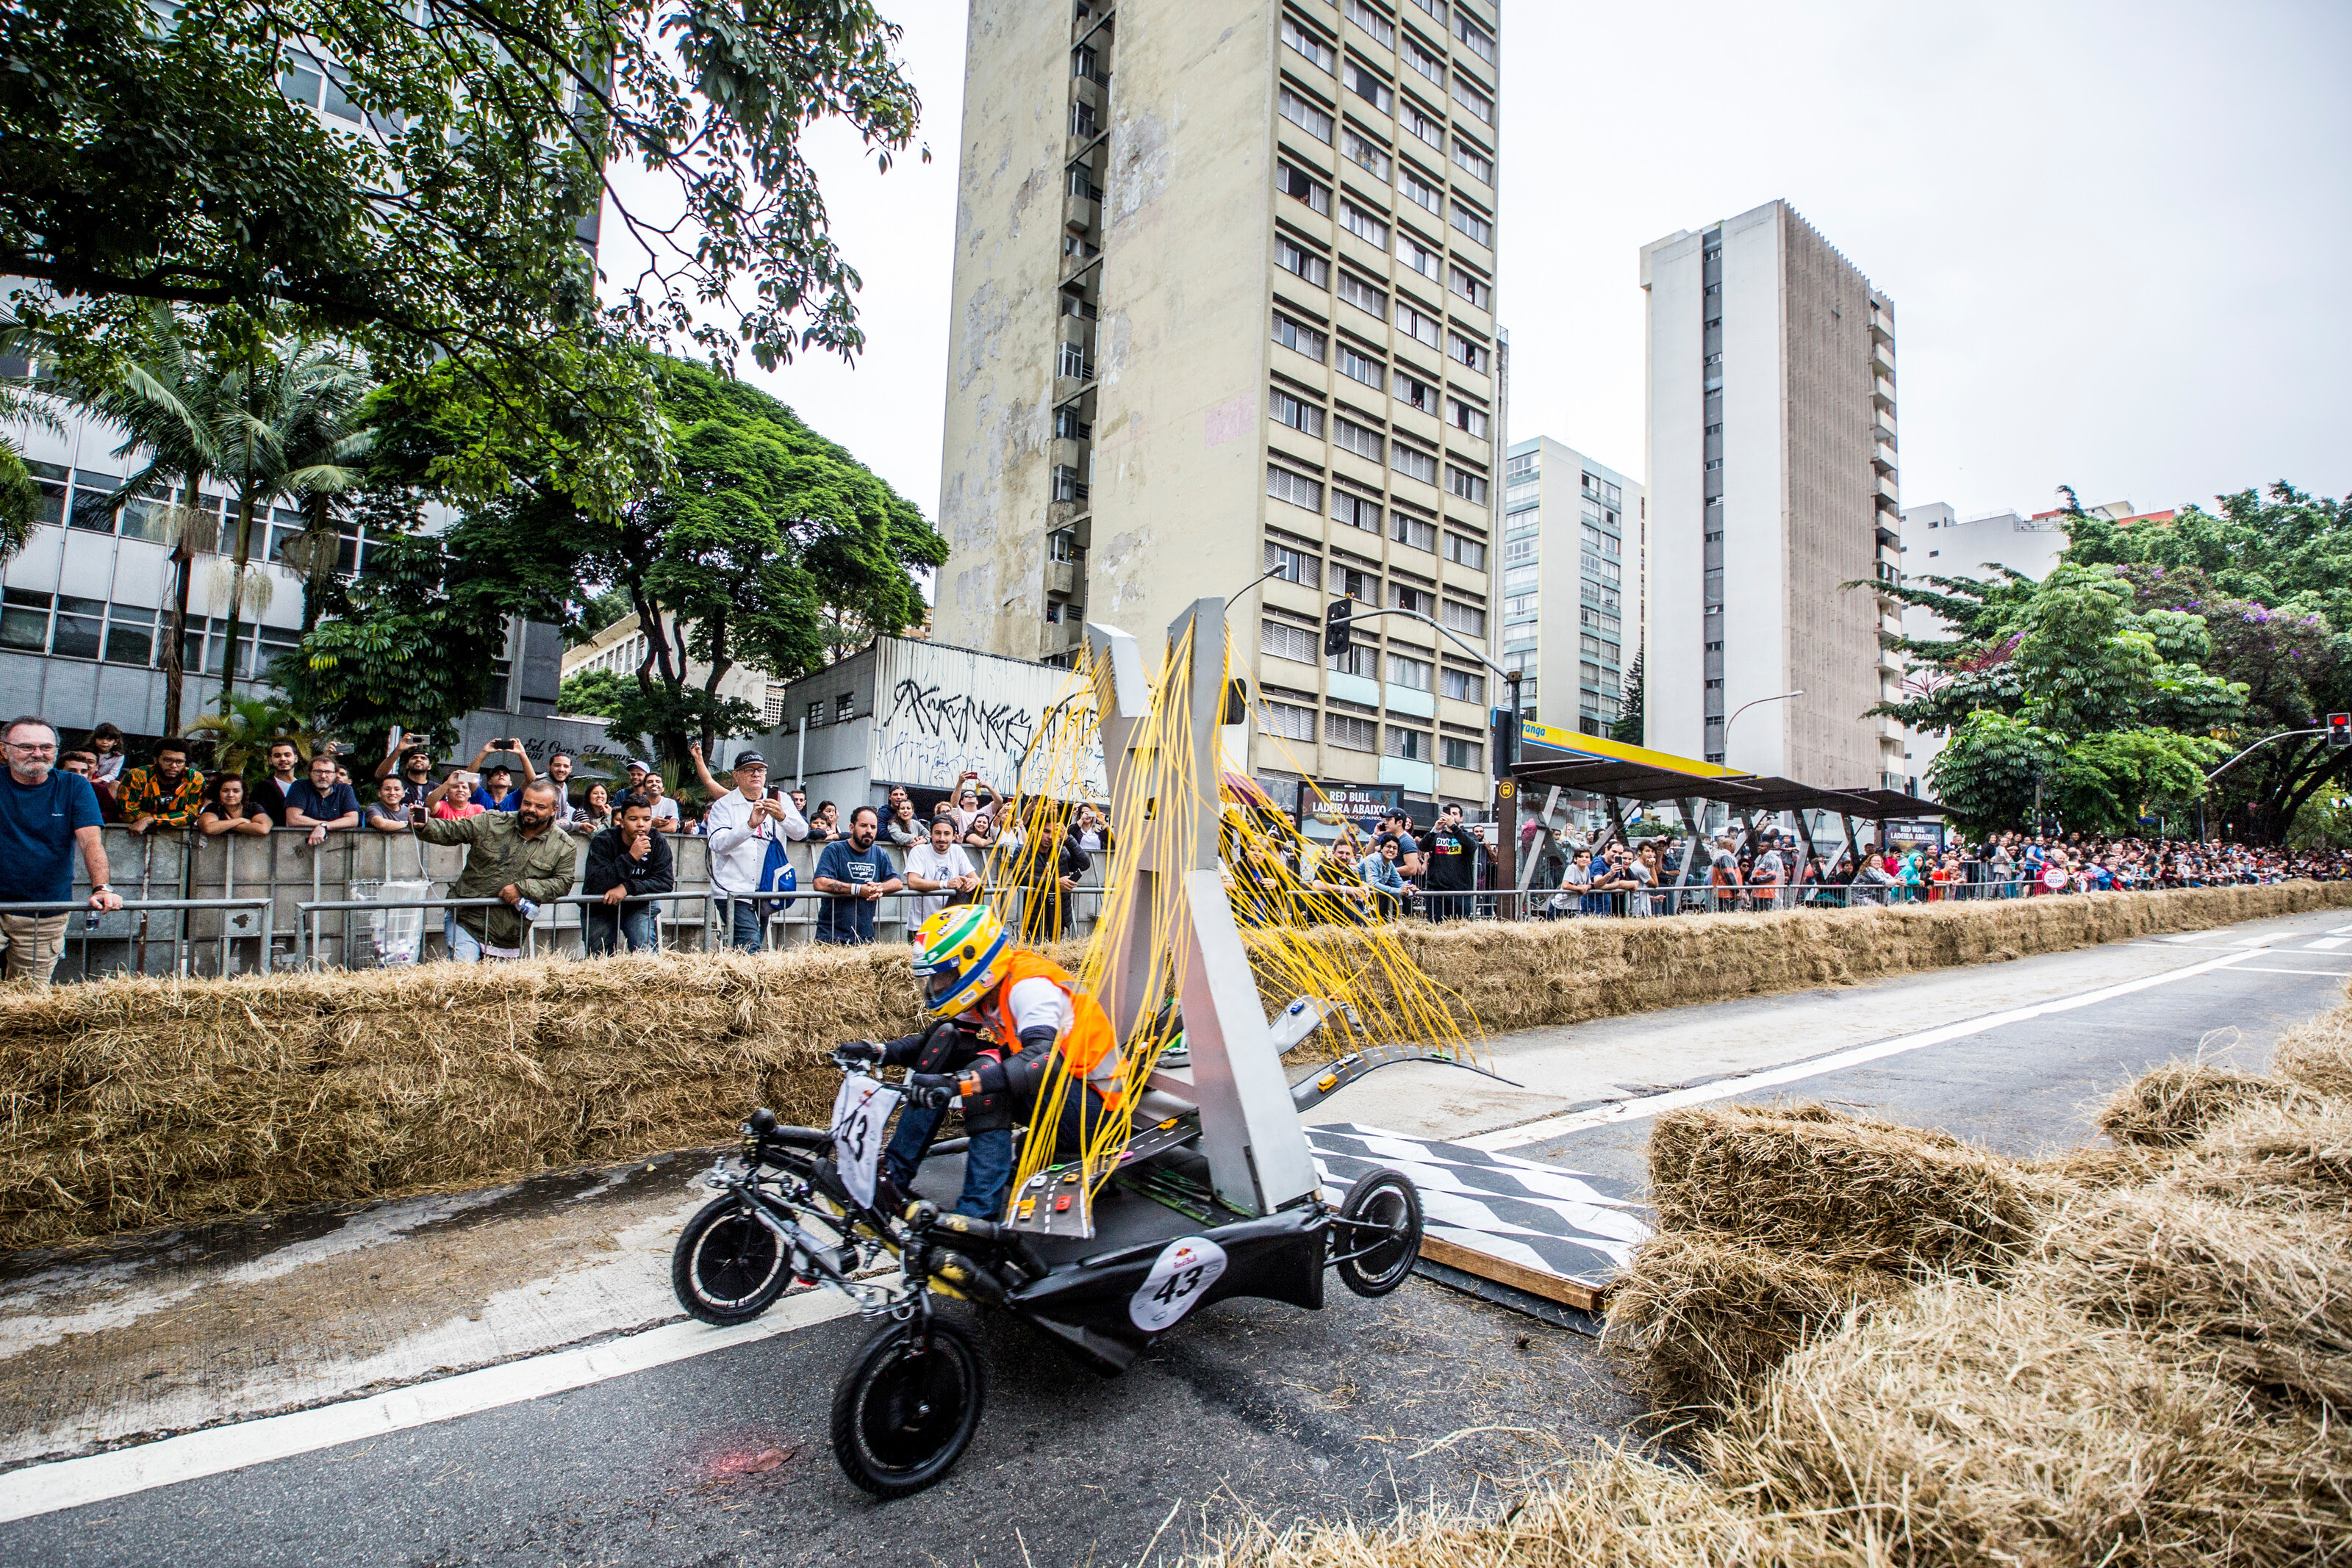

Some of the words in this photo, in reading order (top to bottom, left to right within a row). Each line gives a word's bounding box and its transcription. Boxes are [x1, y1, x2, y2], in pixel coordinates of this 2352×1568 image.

[1329, 791, 1347, 802] RED
[1349, 792, 1370, 802] BULL
[1312, 802, 1350, 814] LADEIRA
[1352, 804, 1386, 816] ABAIXO
[1890, 832, 1913, 840] LADEIRA
[854, 864, 872, 872] VANS
[1152, 1265, 1205, 1306] 43
